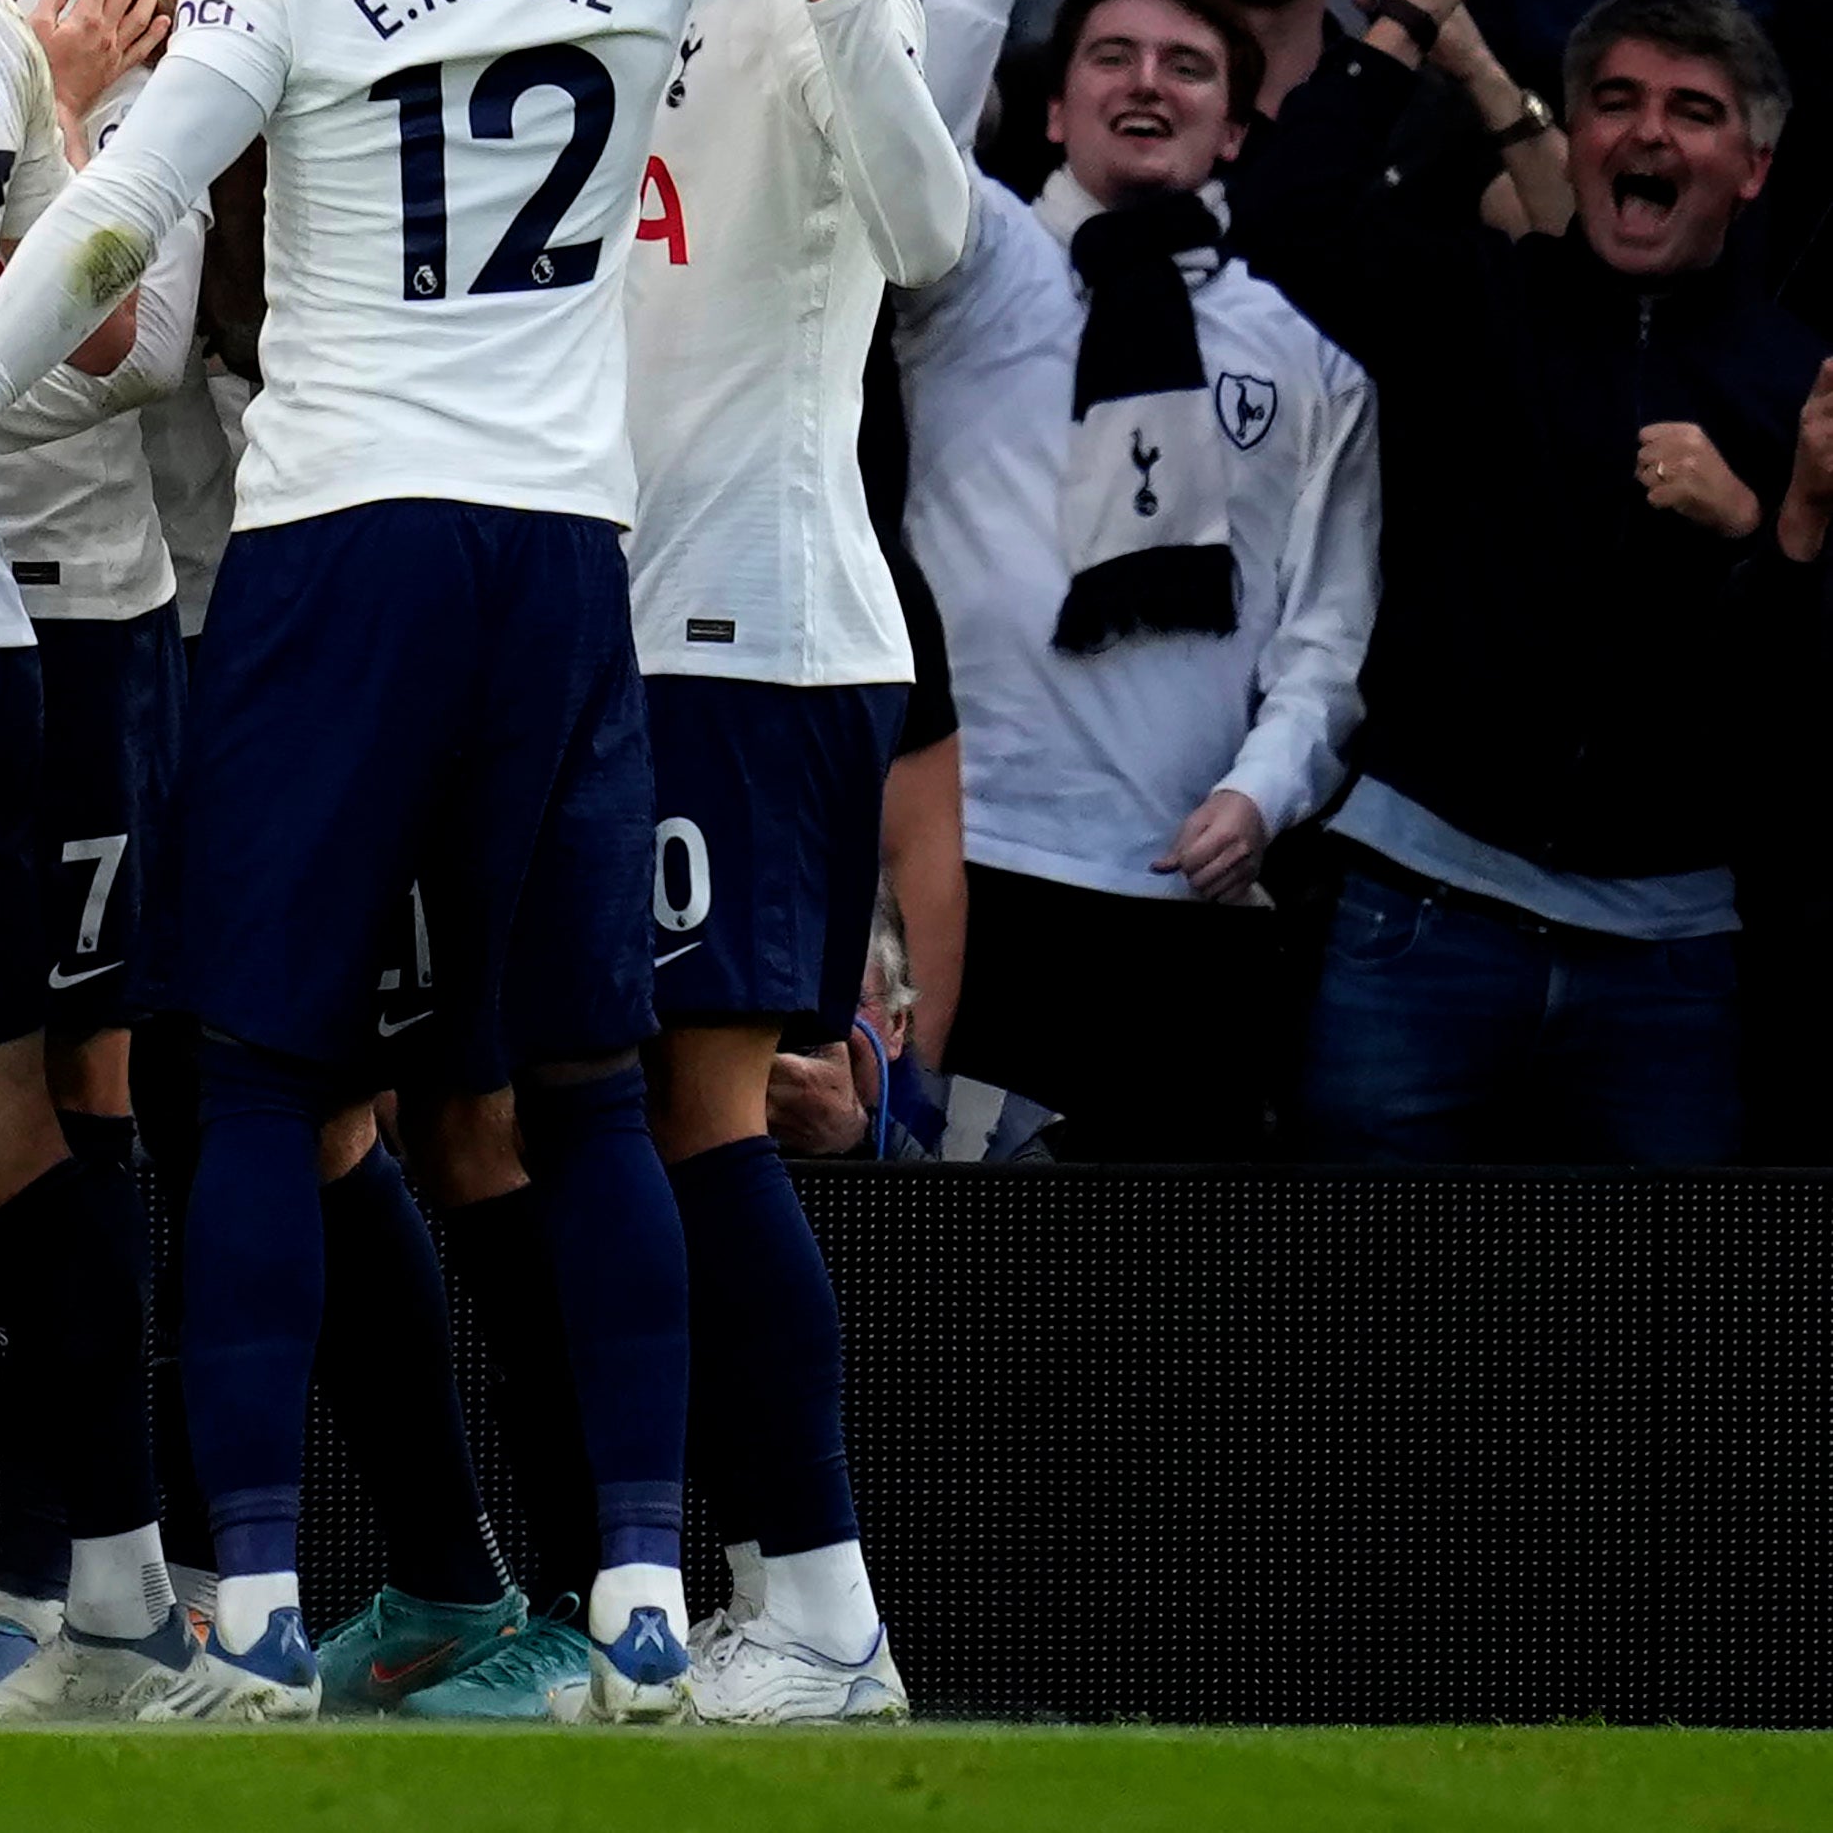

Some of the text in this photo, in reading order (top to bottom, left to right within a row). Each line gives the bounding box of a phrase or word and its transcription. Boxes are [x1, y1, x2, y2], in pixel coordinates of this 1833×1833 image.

[368, 44, 616, 300] 12
[61, 833, 129, 955] 7
[377, 878, 434, 992] 1
